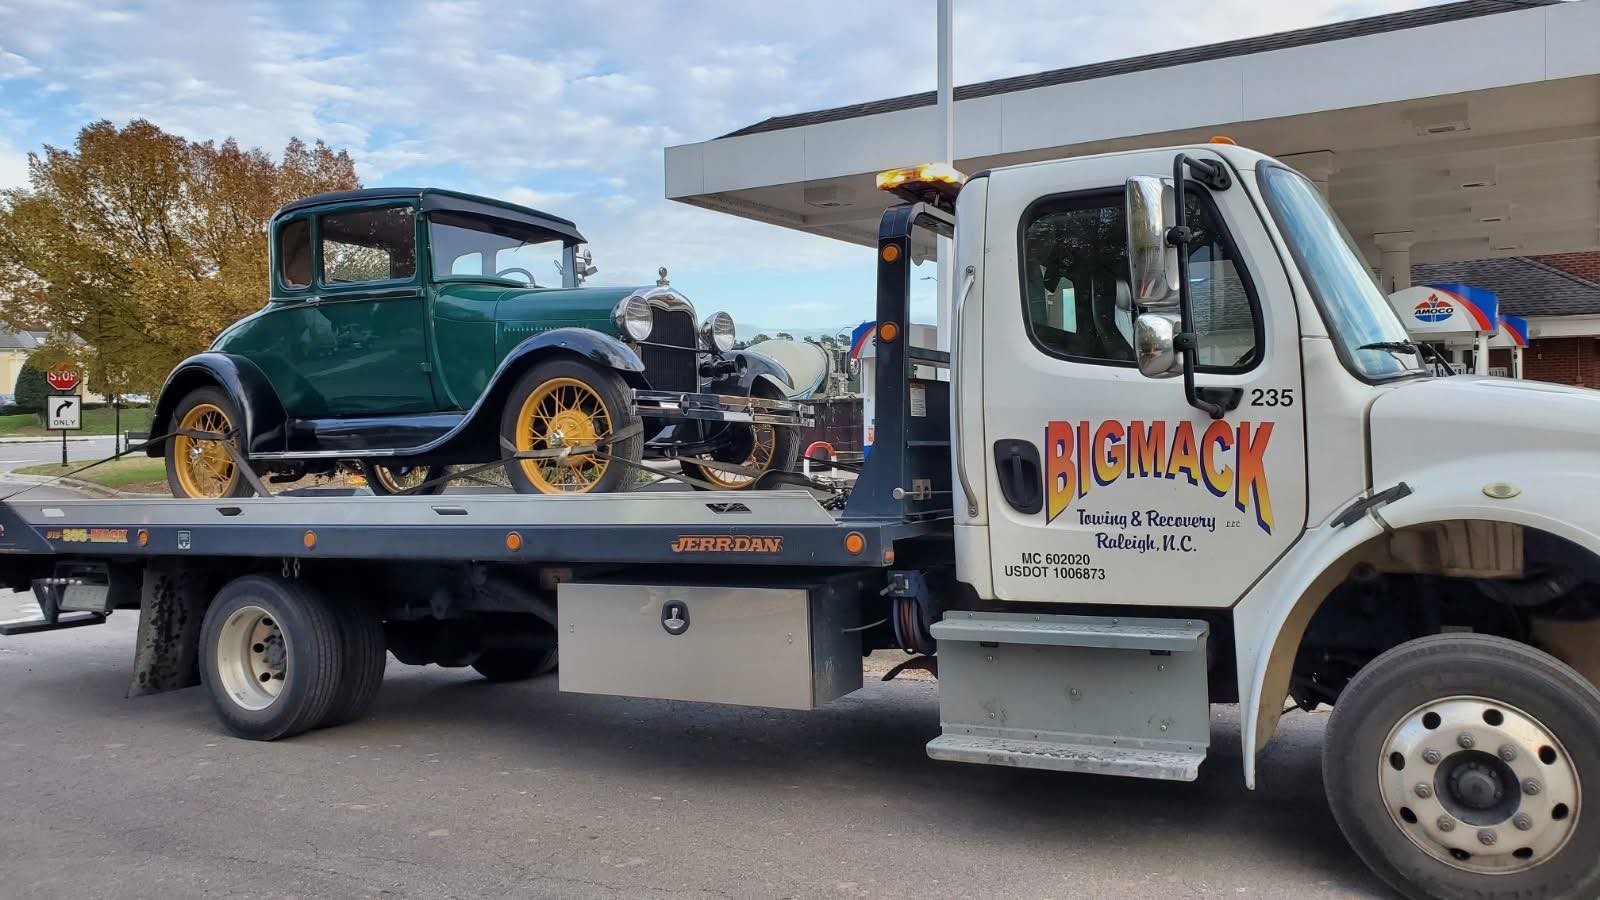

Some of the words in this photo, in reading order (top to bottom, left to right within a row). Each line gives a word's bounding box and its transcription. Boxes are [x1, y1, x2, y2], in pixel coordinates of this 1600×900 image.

[1414, 307, 1454, 315] AMOCO
[1250, 388, 1294, 407] 235
[1045, 419, 1275, 536] BIGMACK
[1077, 508, 1127, 530] Towing
[1130, 510, 1142, 527] &
[1145, 510, 1216, 532] Recovery
[1095, 532, 1160, 553] Raleigh,
[1163, 535, 1197, 552] N.C.
[1021, 552, 1042, 564] MC
[1045, 553, 1090, 565] 602020
[1004, 565, 1049, 578] USDOT
[1053, 567, 1106, 580] 1006873
